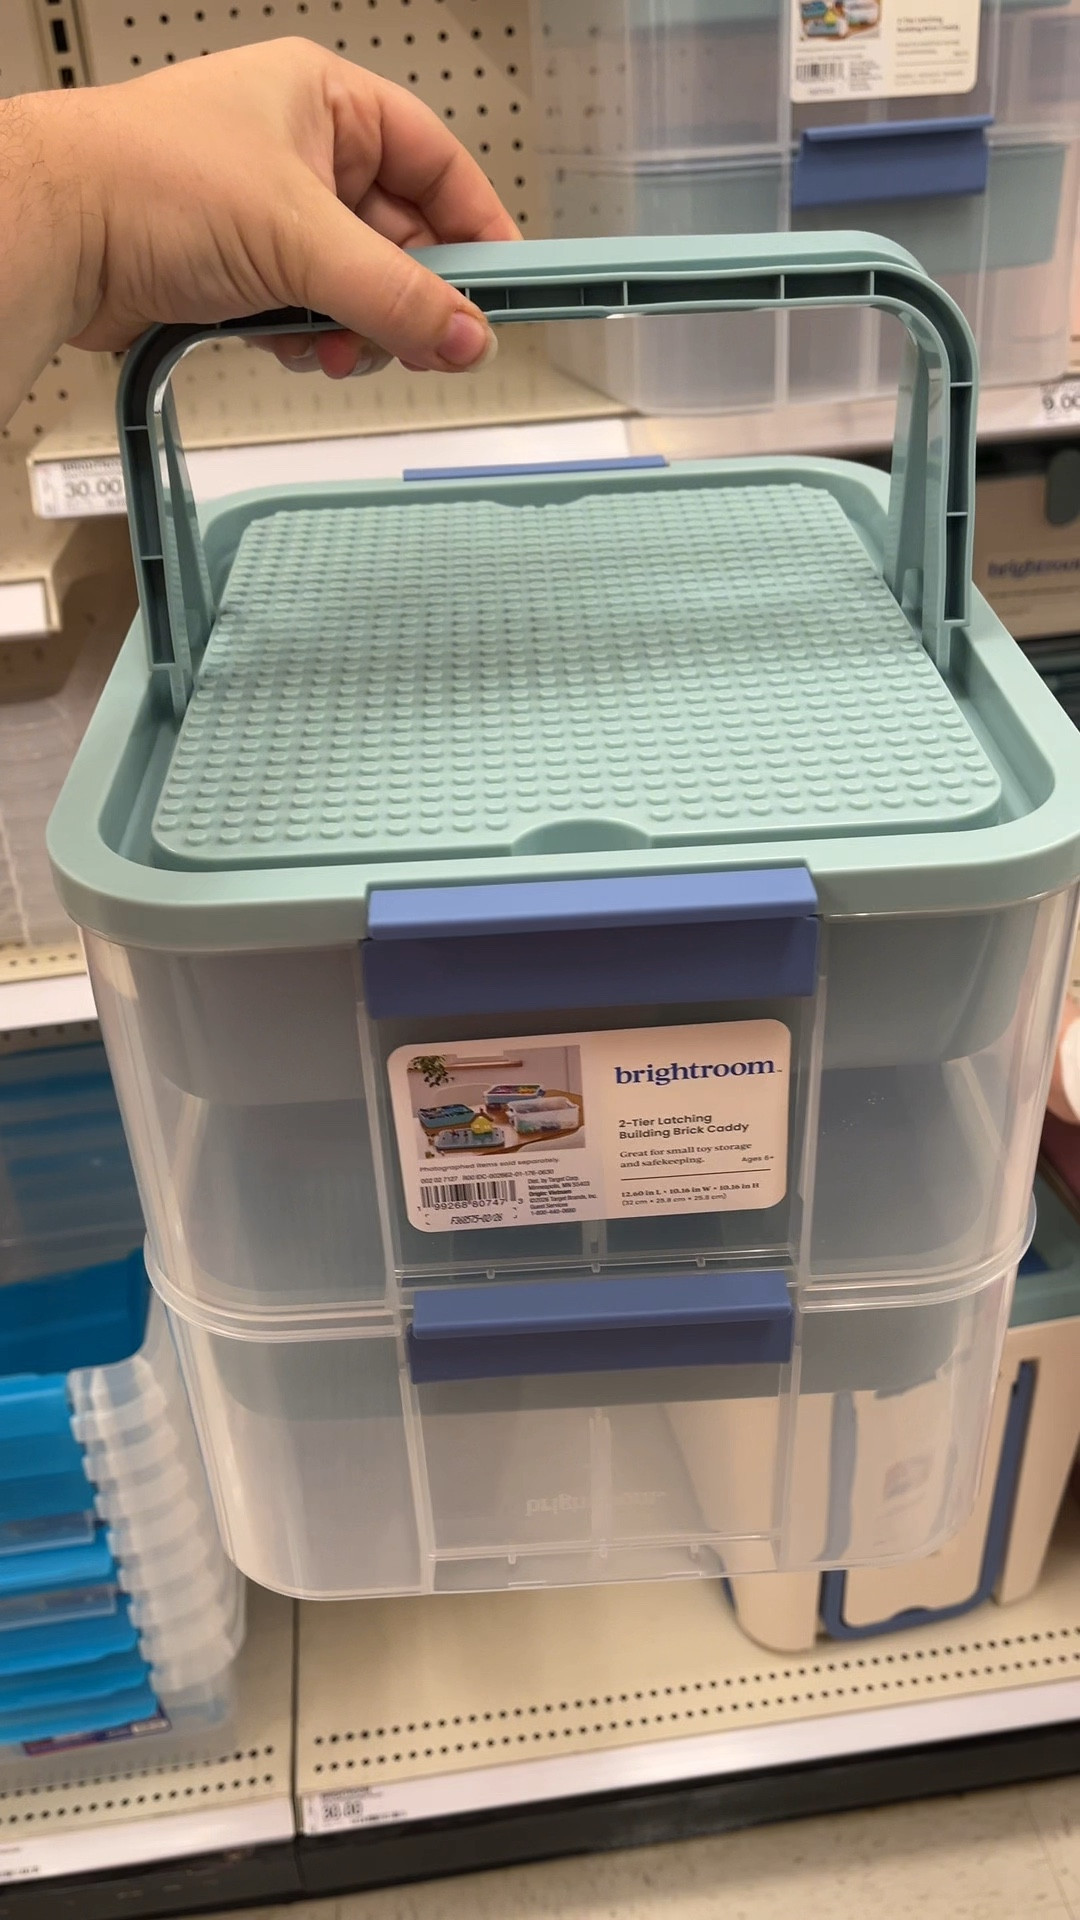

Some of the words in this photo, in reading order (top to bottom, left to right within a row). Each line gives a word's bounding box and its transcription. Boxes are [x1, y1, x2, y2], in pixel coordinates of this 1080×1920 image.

[619, 1118, 655, 1128] 2-Tier
[658, 1114, 712, 1125] Latching
[619, 1129, 671, 1140] Building
[673, 1126, 704, 1136] Brick
[707, 1122, 749, 1133] Caddy
[619, 1150, 648, 1158] Great
[649, 1148, 665, 1156] for
[666, 1146, 695, 1154] small
[696, 1145, 712, 1154] toy
[714, 1143, 752, 1152] storage
[620, 1159, 640, 1168] and
[641, 1156, 705, 1167] safekeeping.
[741, 1155, 762, 1163] Ages
[419, 1163, 475, 1172] Photographed
[434, 1202, 468, 1211] 99268
[472, 1198, 505, 1208] 80747
